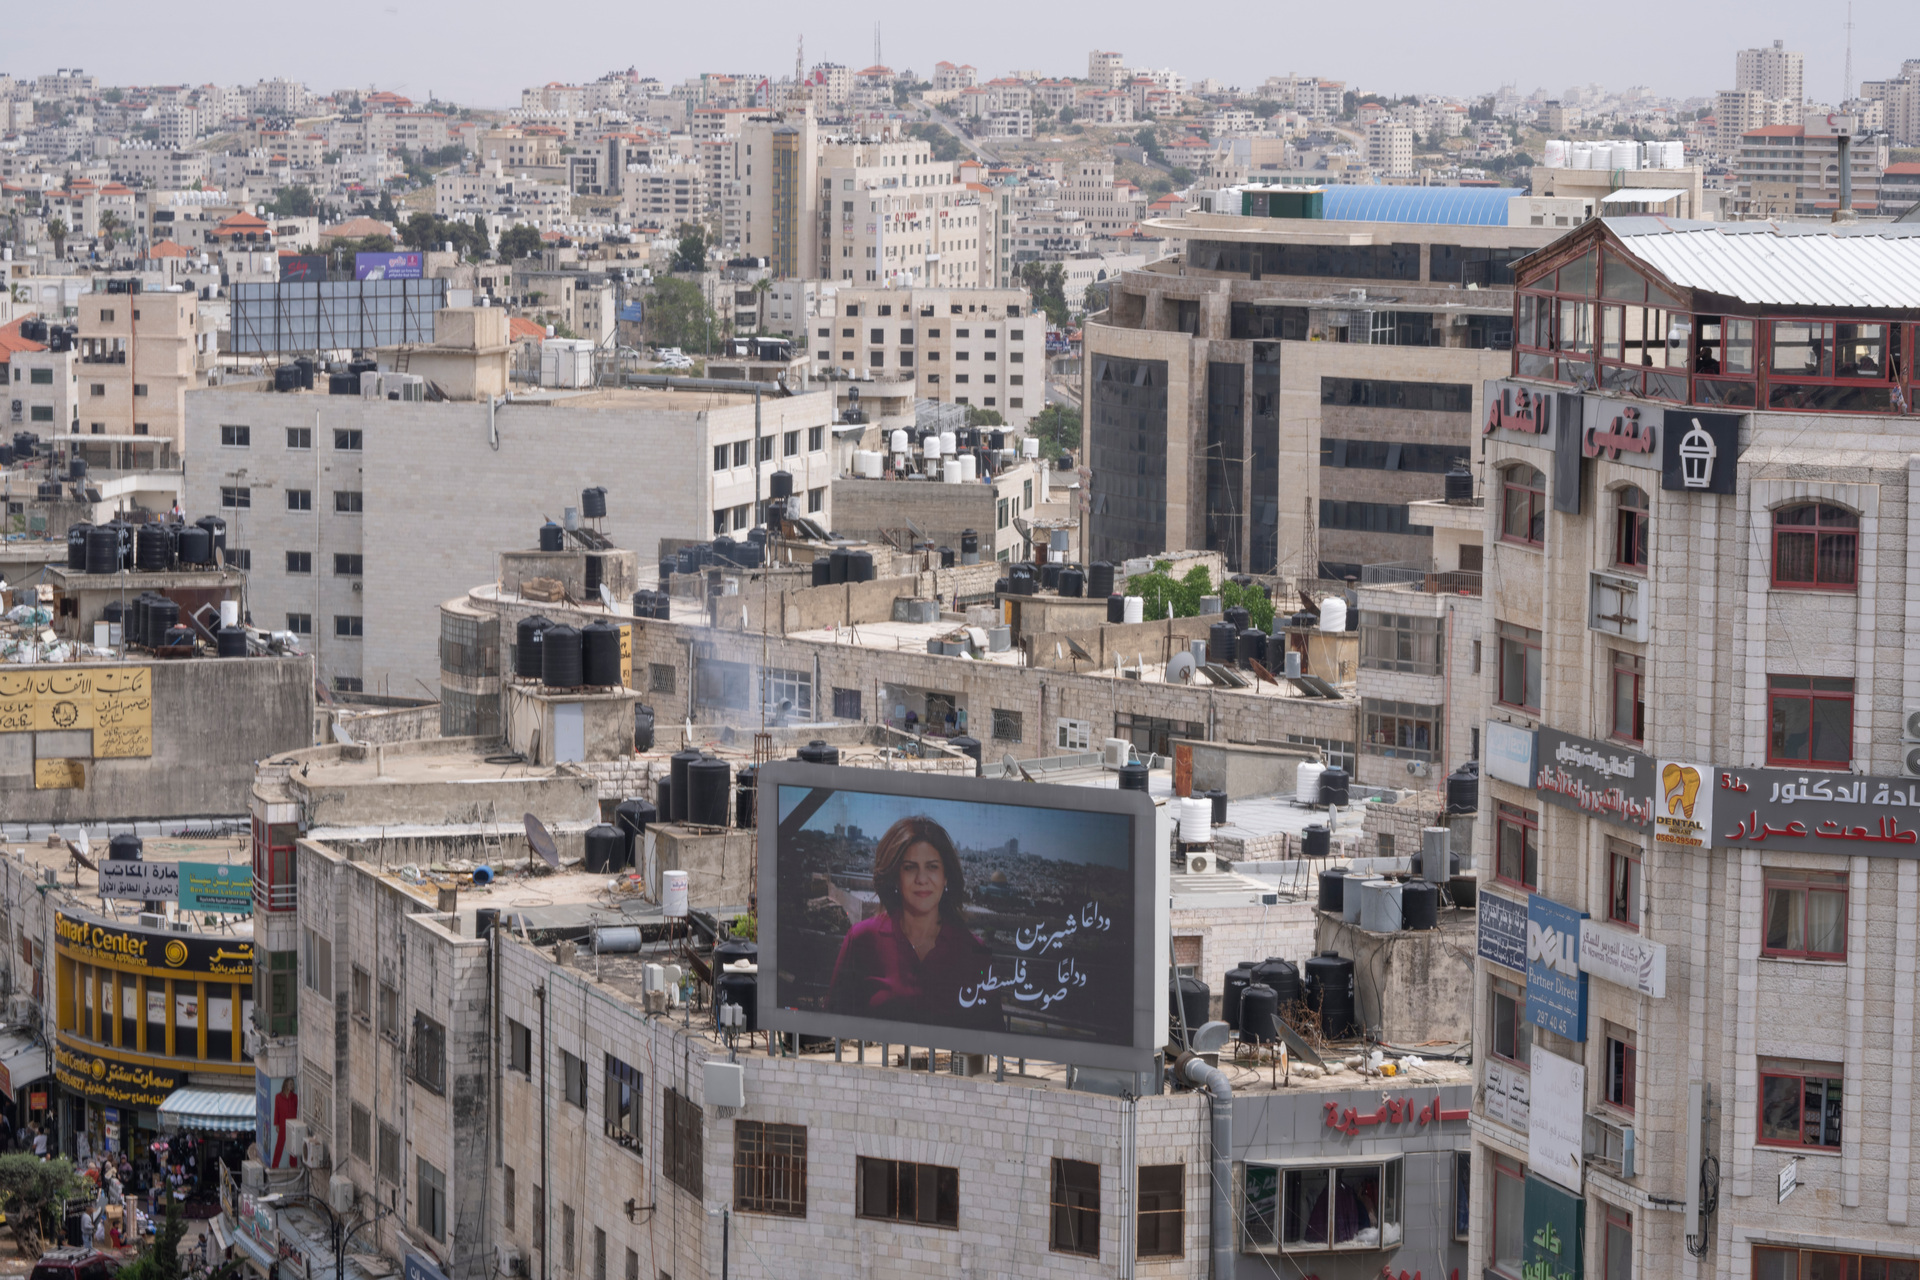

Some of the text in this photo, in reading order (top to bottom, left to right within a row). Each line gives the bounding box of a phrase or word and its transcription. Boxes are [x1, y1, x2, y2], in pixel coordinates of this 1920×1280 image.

[288, 260, 308, 280] Sky
[1482, 387, 1656, 460] مقهى الشام
[97, 669, 145, 697] مكتب
[1769, 777, 1867, 804] الدكتور
[1656, 816, 1703, 830] DENTAL
[1669, 827, 1692, 836] IMPLANT
[1724, 810, 1918, 844] طلعت عرار
[104, 864, 179, 880] مارة المكاتب
[55, 911, 148, 956] Smart Center
[1015, 914, 1078, 955] شيرين
[1527, 919, 1578, 978] DELL
[1621, 943, 1638, 964] وكالة
[1605, 953, 1619, 967] Travel
[1619, 959, 1639, 976] Agency
[958, 957, 1027, 1008] فلسطين
[1528, 966, 1578, 1001] Partner Direct
[1014, 983, 1068, 1011] صوت
[1536, 1009, 1567, 1034] 297 40 45
[105, 1063, 174, 1089] سمارت سنتر
